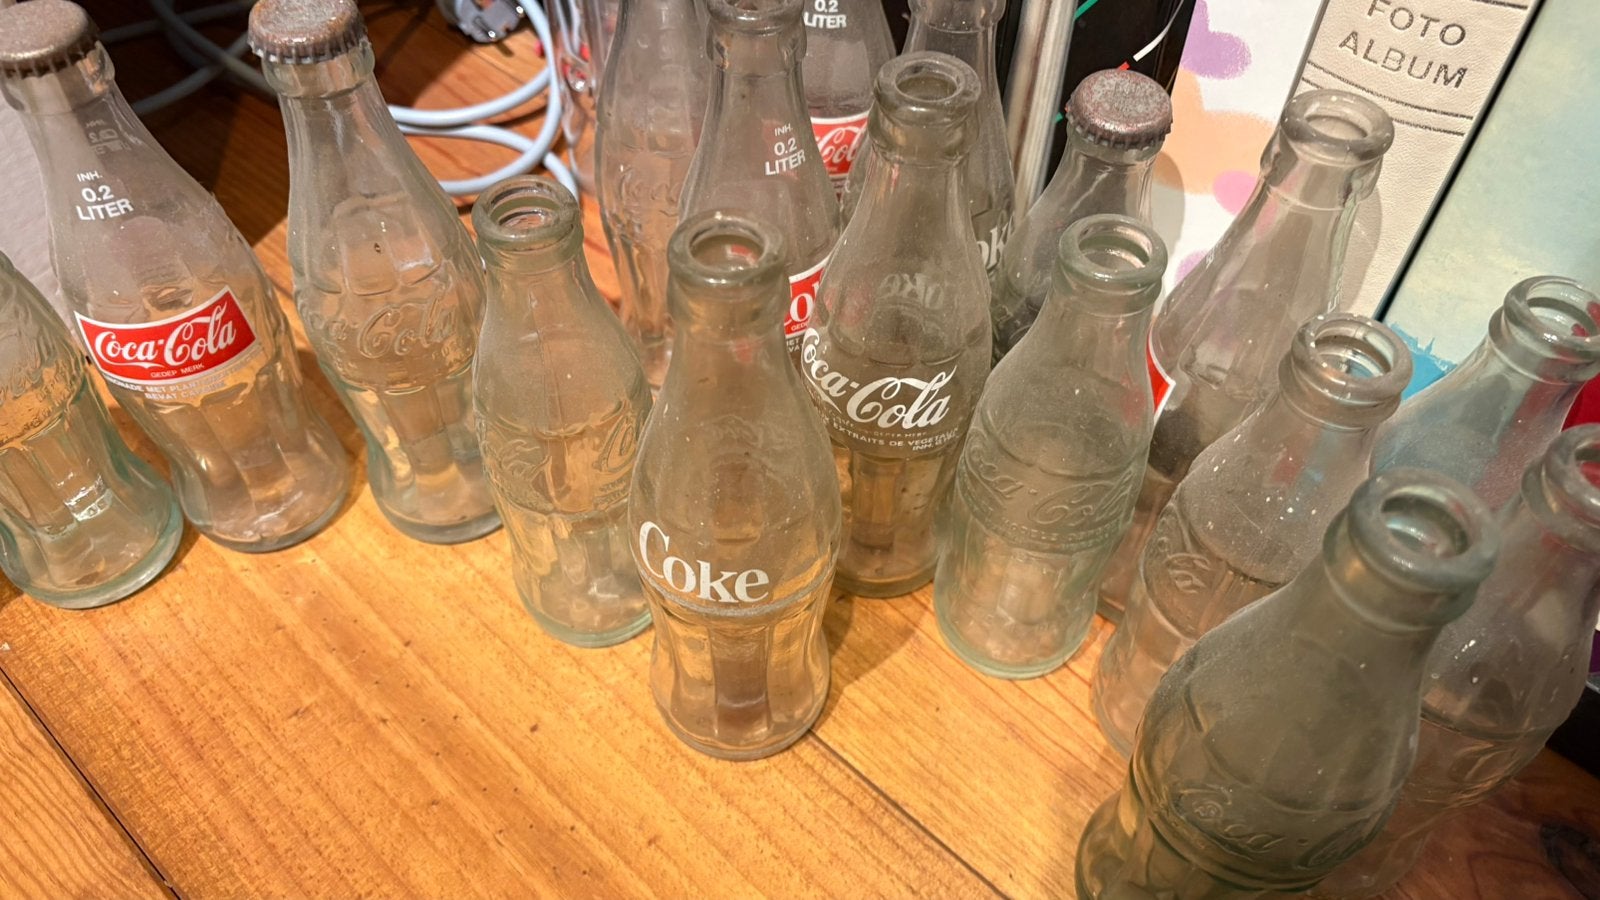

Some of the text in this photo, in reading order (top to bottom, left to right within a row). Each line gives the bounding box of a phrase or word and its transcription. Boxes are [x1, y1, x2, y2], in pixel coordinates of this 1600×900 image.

[814, 0, 838, 13] 0.2
[803, 11, 847, 29] LITER
[1367, 0, 1466, 46] FOTO
[1338, 30, 1468, 89] ALBUM
[774, 123, 793, 137] INH.
[774, 137, 797, 156] 0.2
[765, 149, 806, 176] LITER
[76, 170, 103, 182] INH.
[81, 185, 115, 202] 0.2
[75, 198, 135, 221] LITER
[95, 301, 237, 369] Coca-Cola
[150, 363, 205, 379] GEDEP MERK
[801, 327, 958, 430] Coca-Cola
[639, 520, 770, 604] Coke
